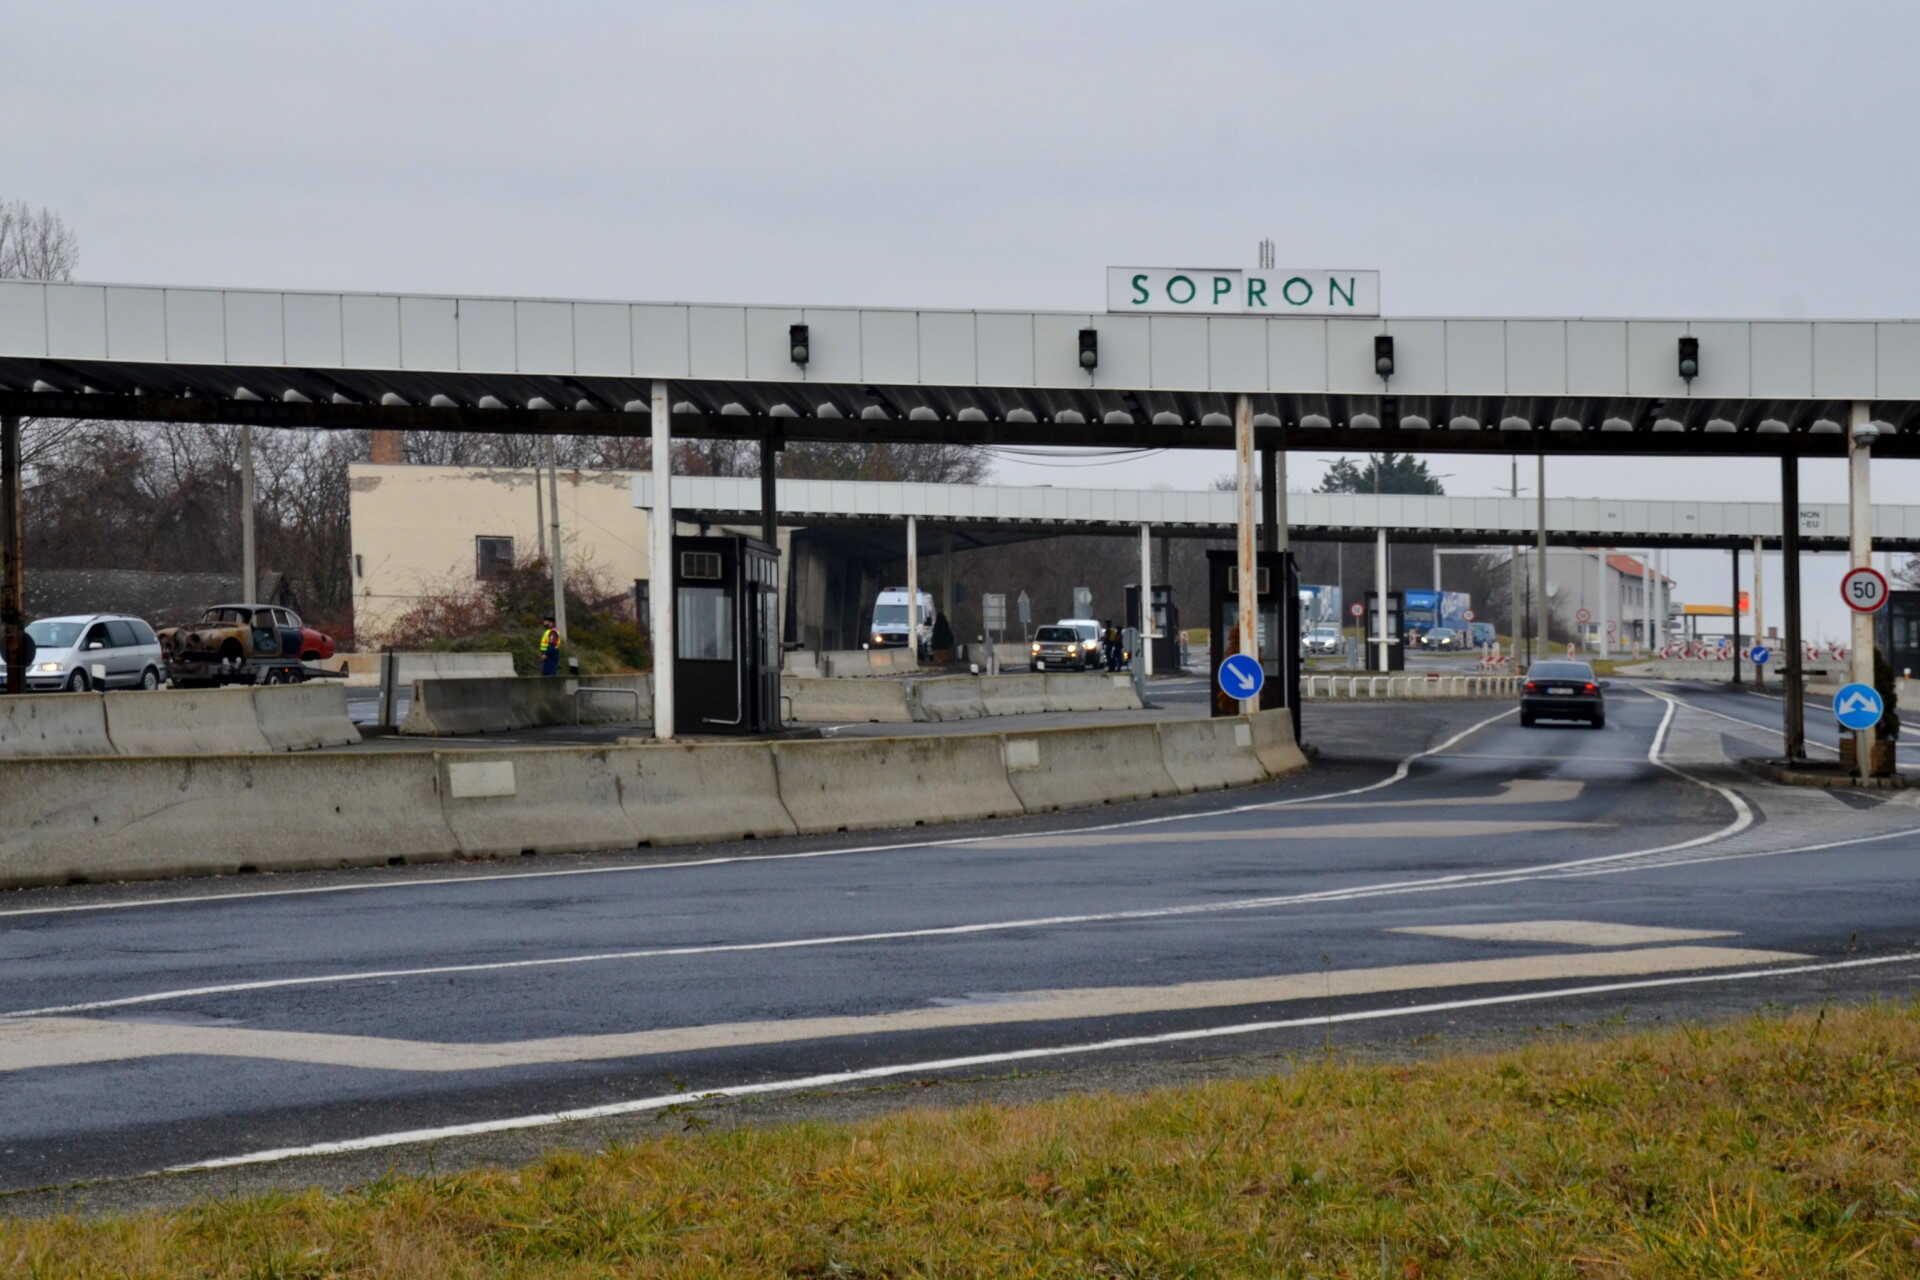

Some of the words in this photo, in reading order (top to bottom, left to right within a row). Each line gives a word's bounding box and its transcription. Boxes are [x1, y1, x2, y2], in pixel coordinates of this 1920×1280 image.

[1131, 274, 1355, 306] SOPRON
[1800, 511, 1820, 519] NON
[1853, 581, 1876, 599] 50
